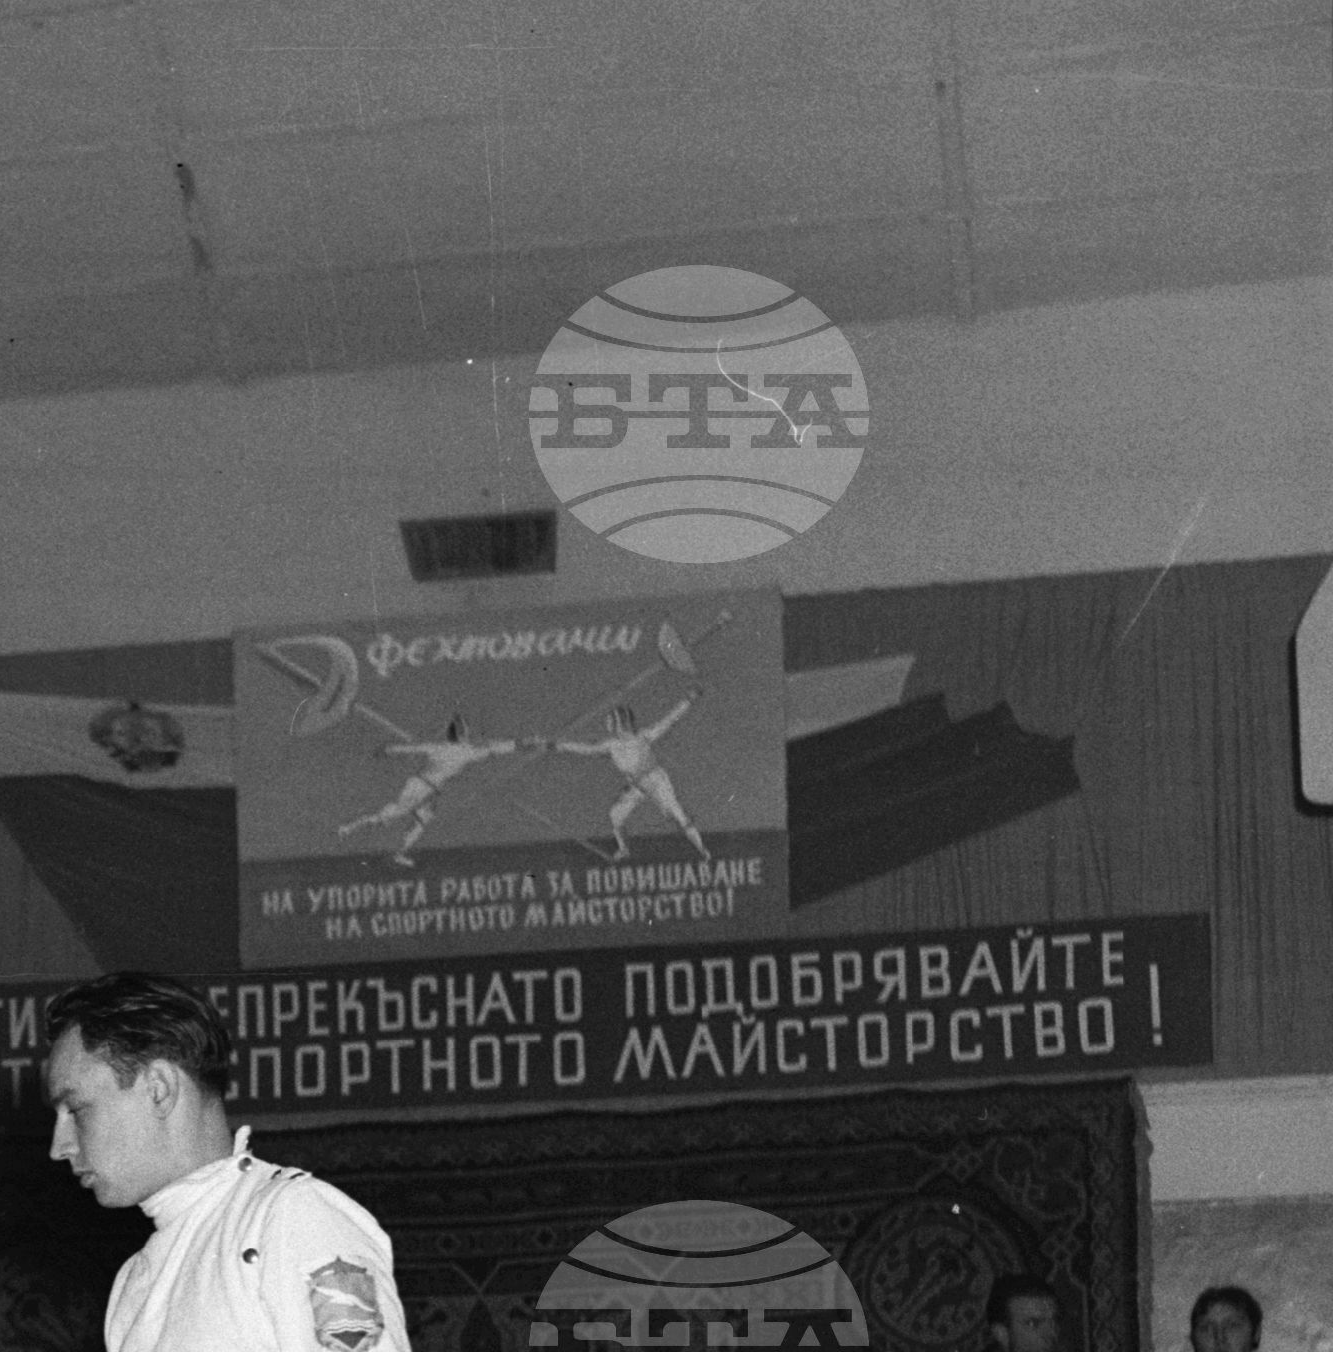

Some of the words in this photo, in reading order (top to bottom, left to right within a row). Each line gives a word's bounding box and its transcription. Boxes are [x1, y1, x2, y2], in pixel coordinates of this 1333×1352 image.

[261, 888, 295, 915] НА
[306, 879, 428, 913] УПОРИТА
[440, 870, 536, 903] РАБОТА
[546, 869, 576, 899] ЗА
[586, 856, 763, 895] ПОВИШАВАНЕ
[325, 913, 363, 940] НА
[370, 903, 516, 938] СПОРТНОТО
[625, 927, 1125, 1020] ПОДОБРЯВАЙТЕ
[226, 1031, 586, 1100] ПОРТНОТО
[613, 996, 1116, 1083] МАЙСТОРСТВО
